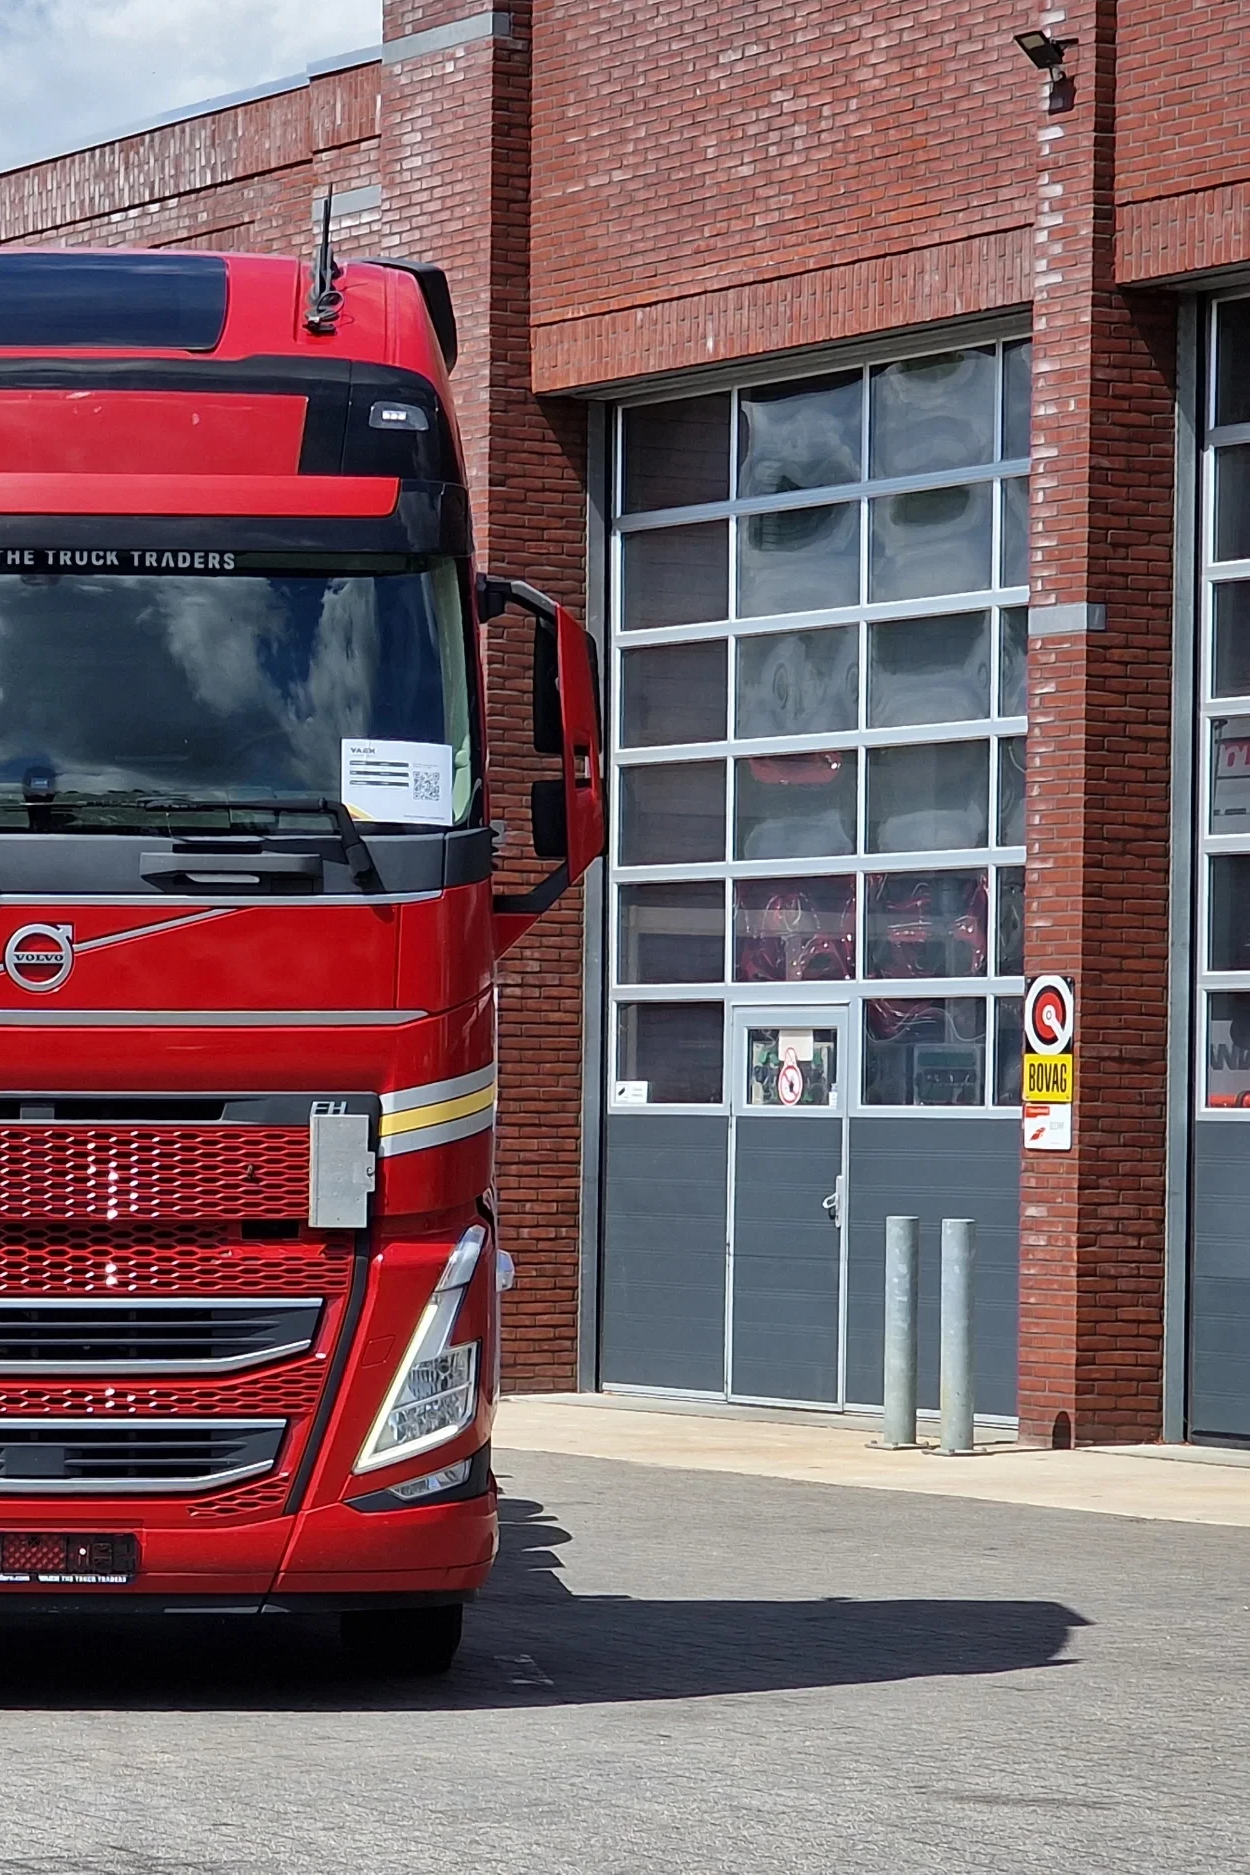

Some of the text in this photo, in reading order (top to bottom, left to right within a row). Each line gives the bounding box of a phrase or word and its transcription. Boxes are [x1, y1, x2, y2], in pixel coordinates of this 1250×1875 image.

[44, 550, 119, 566] TRUCK
[130, 551, 235, 570] TRADERS
[13, 953, 64, 962] VOLVO
[1029, 1063, 1067, 1093] BOVAG
[310, 1101, 347, 1115] FH
